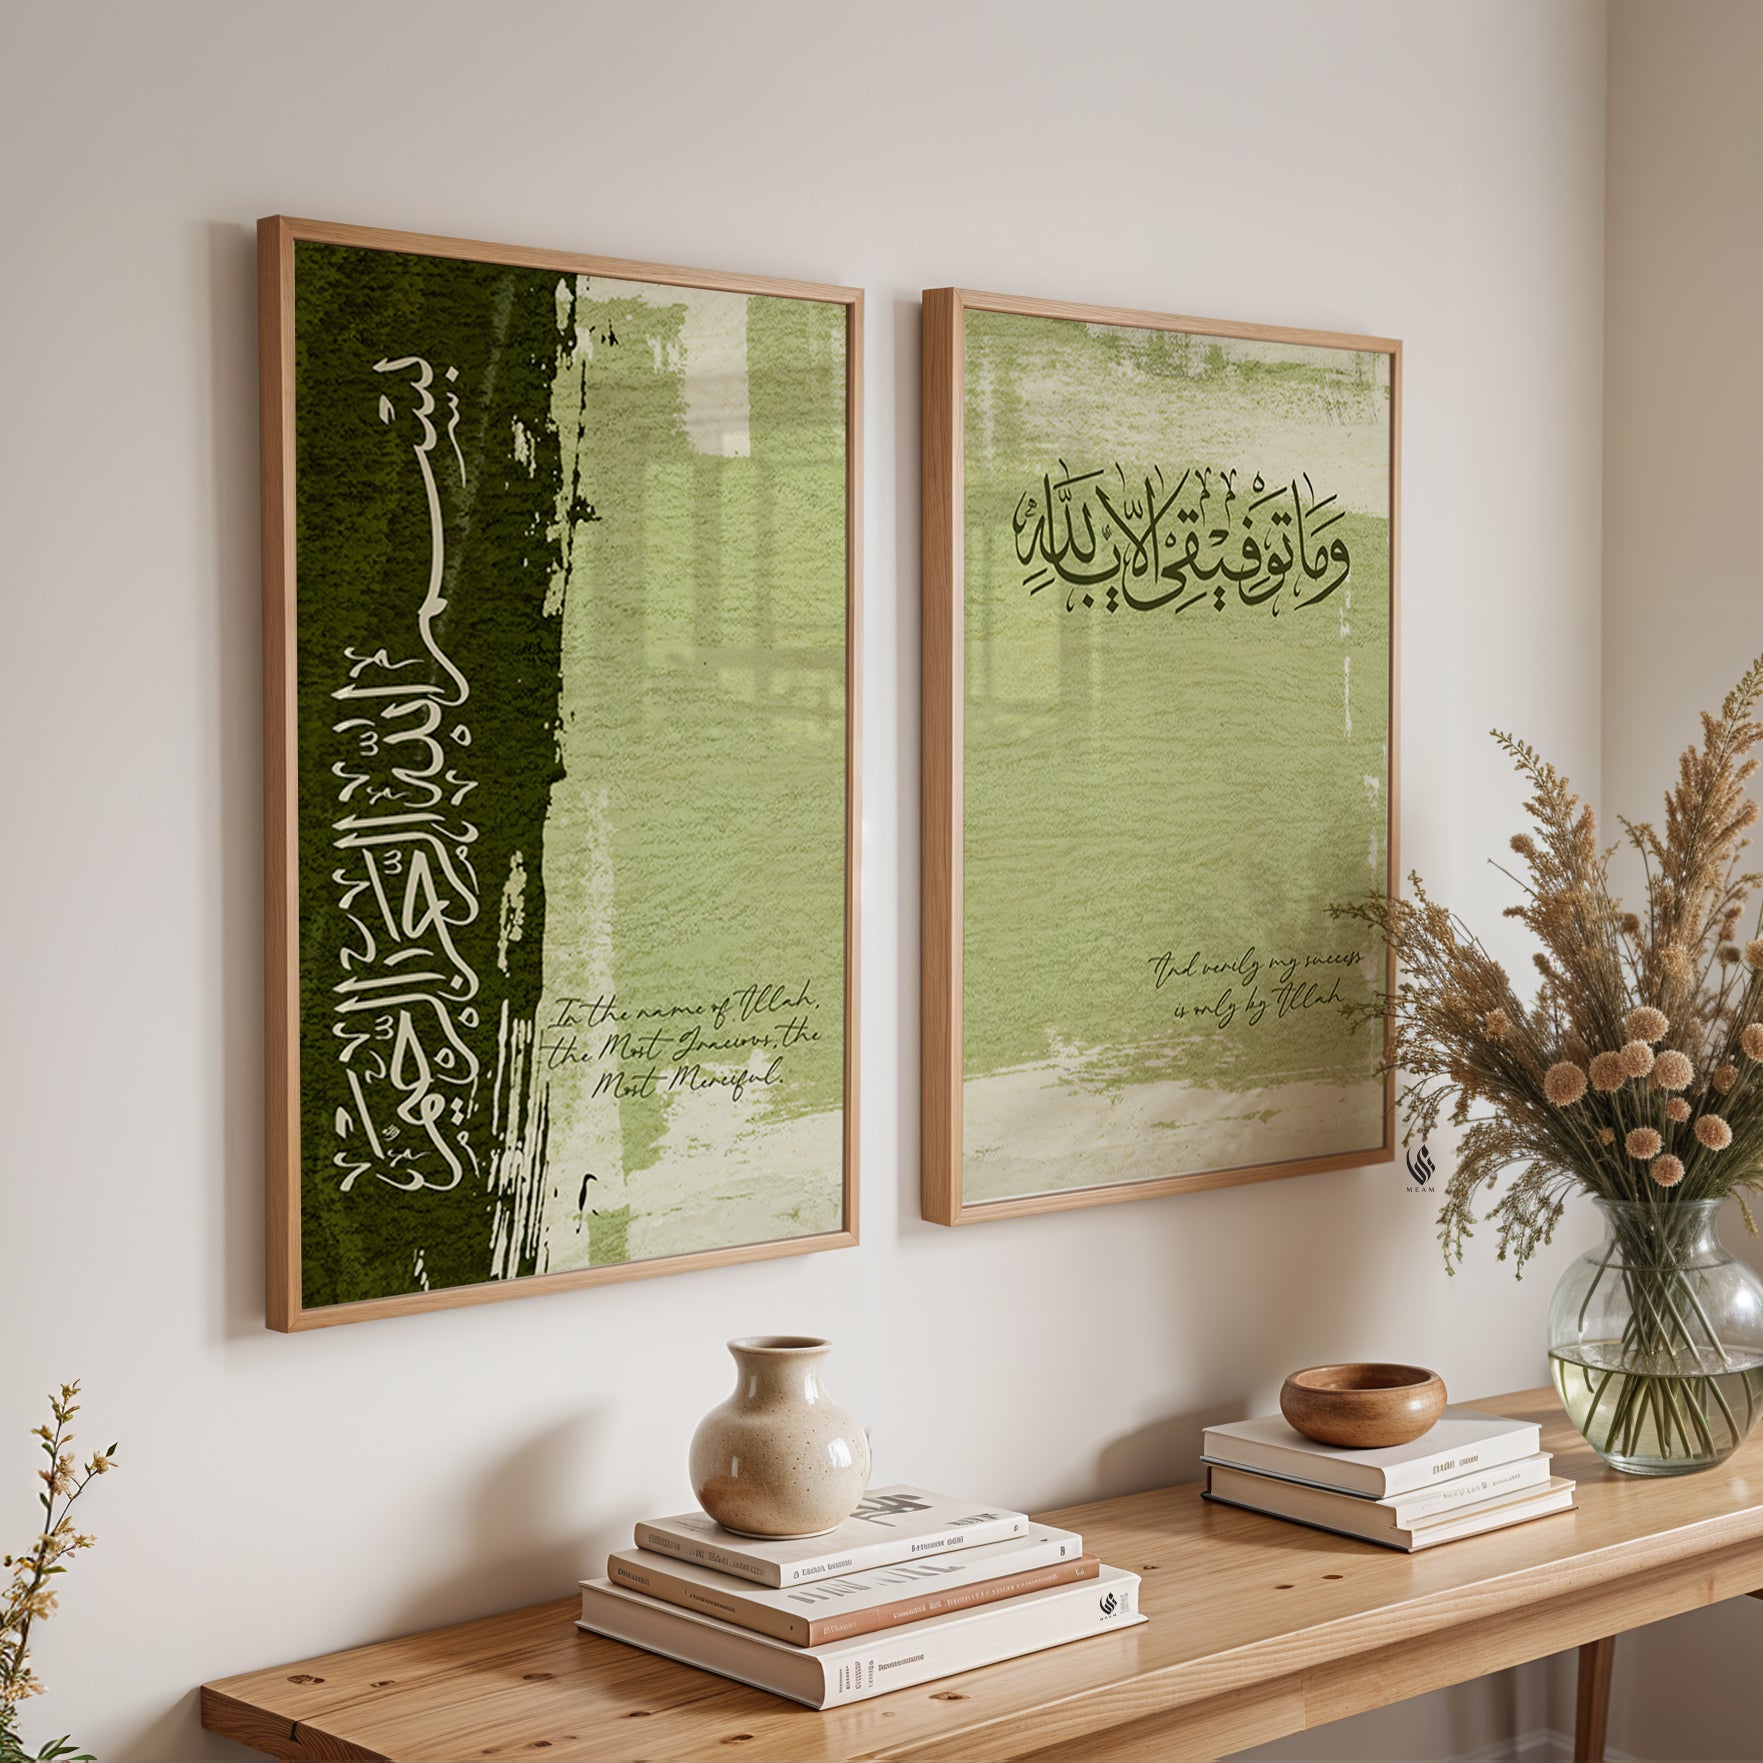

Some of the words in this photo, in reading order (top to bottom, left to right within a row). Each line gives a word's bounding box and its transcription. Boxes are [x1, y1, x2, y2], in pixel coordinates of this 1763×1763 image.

[1148, 951, 1198, 989] And
[1203, 946, 1264, 986] verily
[1268, 957, 1301, 984] my
[1305, 950, 1365, 970] success
[548, 997, 583, 1030] In
[581, 995, 635, 1028] the
[636, 1004, 706, 1021] name
[712, 997, 733, 1028] of
[733, 979, 821, 1022] Allah,
[1173, 1001, 1191, 1019] is
[1193, 988, 1240, 1029] only
[1244, 986, 1271, 1027] by
[1271, 977, 1346, 1019] Allah
[541, 1036, 593, 1070] the
[598, 1027, 675, 1061] Most
[672, 1025, 778, 1062] Gracious,
[775, 1016, 821, 1048] the
[591, 1068, 667, 1100] Most
[668, 1056, 784, 1102] Merciful.
